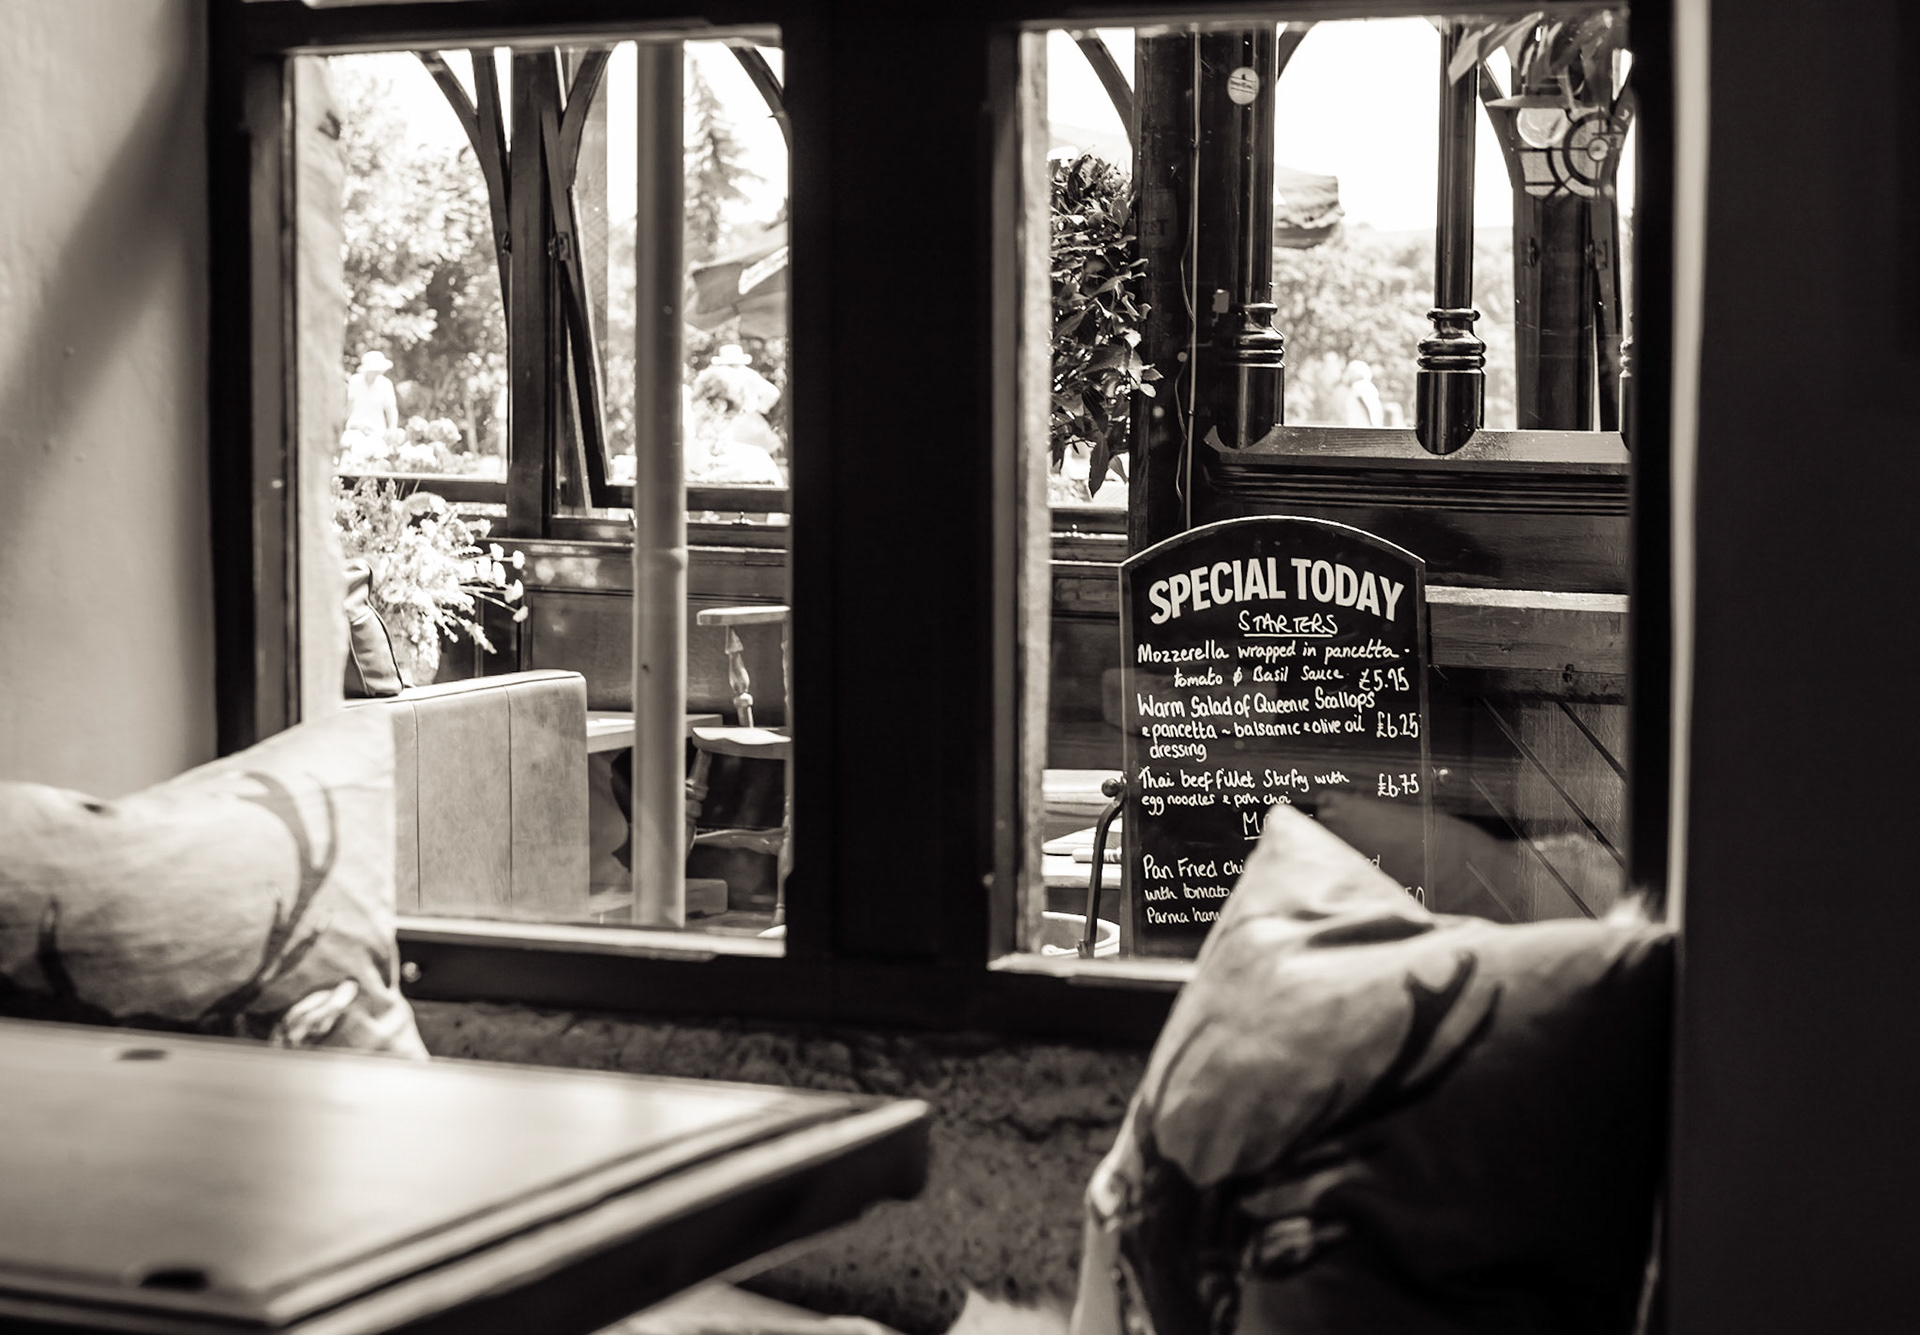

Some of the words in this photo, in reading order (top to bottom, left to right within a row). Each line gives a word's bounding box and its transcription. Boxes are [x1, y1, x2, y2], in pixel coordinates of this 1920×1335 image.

[1149, 557, 1286, 624] SPECIAL
[1291, 558, 1404, 622] TODAY
[1238, 610, 1338, 635] STARTERS
[1138, 639, 1230, 663] Mozzerella
[1237, 639, 1296, 664] wrapped
[1302, 641, 1317, 657] in
[1324, 638, 1400, 665] pancetta
[1174, 666, 1223, 687] tomato
[1252, 665, 1289, 682] Basil
[1359, 666, 1410, 692] £5.95
[1137, 693, 1185, 718] Warm
[1190, 695, 1233, 718] Salad
[1234, 693, 1251, 718] of
[1253, 692, 1310, 714] Queenie
[1315, 686, 1375, 713] Scallops
[1152, 721, 1218, 744] pancetta
[1233, 721, 1301, 738] balsamic
[1311, 718, 1341, 734] olive
[1344, 713, 1365, 733] oil
[1376, 711, 1419, 739] £6.25
[1149, 743, 1207, 762] dressing
[1138, 766, 1175, 789] Thai
[1180, 769, 1213, 792] beef
[1215, 768, 1256, 790] fillet
[1314, 770, 1350, 784] with
[1377, 773, 1420, 798] £6.75
[1141, 795, 1165, 816] egg
[1166, 793, 1216, 807] noodles
[1263, 791, 1292, 805] choi
[1142, 854, 1175, 880] Pan
[1177, 857, 1218, 878] Fried
[1144, 886, 1178, 901] with
[1146, 906, 1190, 924] Parma
